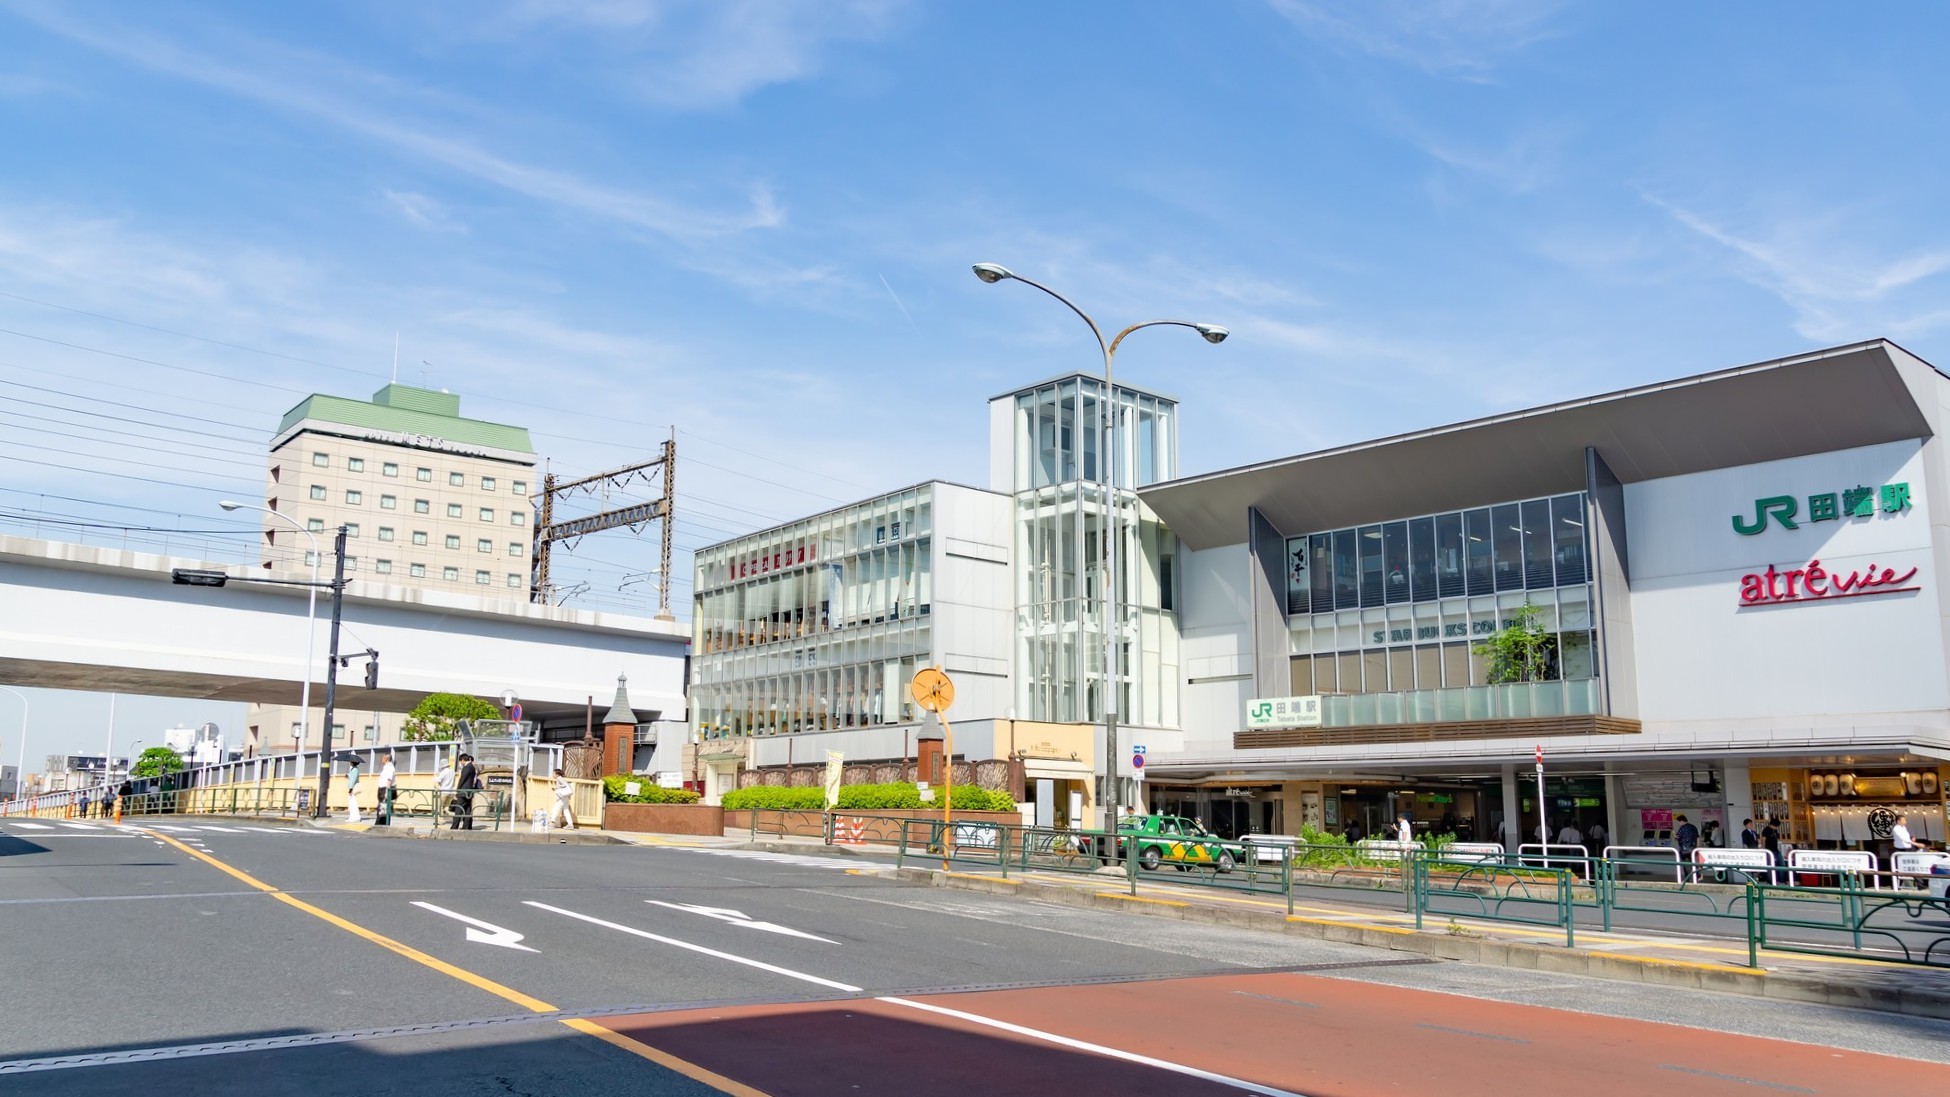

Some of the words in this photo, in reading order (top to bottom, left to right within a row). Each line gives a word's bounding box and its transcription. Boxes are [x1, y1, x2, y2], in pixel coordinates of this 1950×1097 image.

[1732, 494, 1799, 536] JR
[1808, 482, 1912, 521] 田端駅
[1740, 559, 1828, 602] atré
[1832, 563, 1918, 593] vie
[1373, 621, 1468, 644] SARBUKS
[1252, 703, 1272, 718] JR
[1276, 701, 1316, 713] 田端駅
